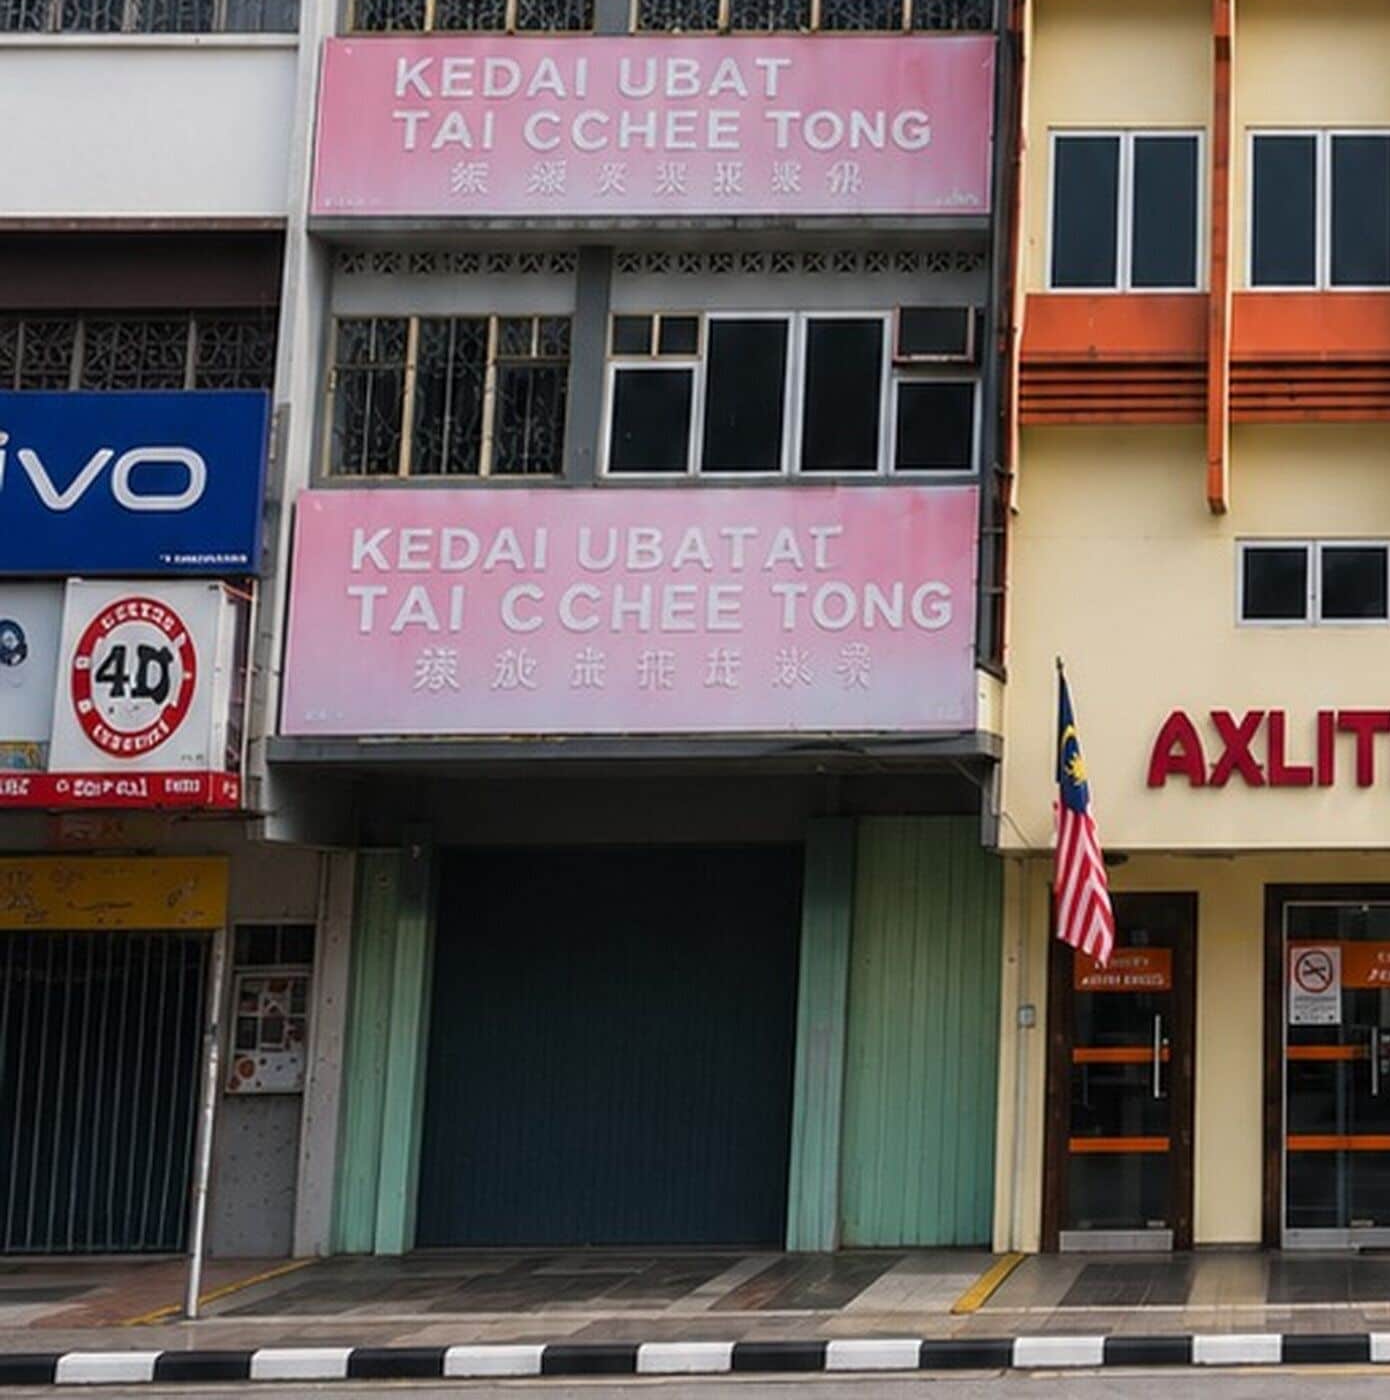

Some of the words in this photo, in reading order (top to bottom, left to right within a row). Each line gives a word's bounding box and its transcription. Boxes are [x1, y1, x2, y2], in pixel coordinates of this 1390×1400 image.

[395, 57, 588, 99] KEDAI
[618, 57, 792, 99] UBAT
[392, 109, 496, 151] TAI
[765, 108, 933, 151] TONG
[351, 526, 547, 572] KEDAI
[347, 584, 466, 634] TAI
[771, 581, 954, 633] TONG
